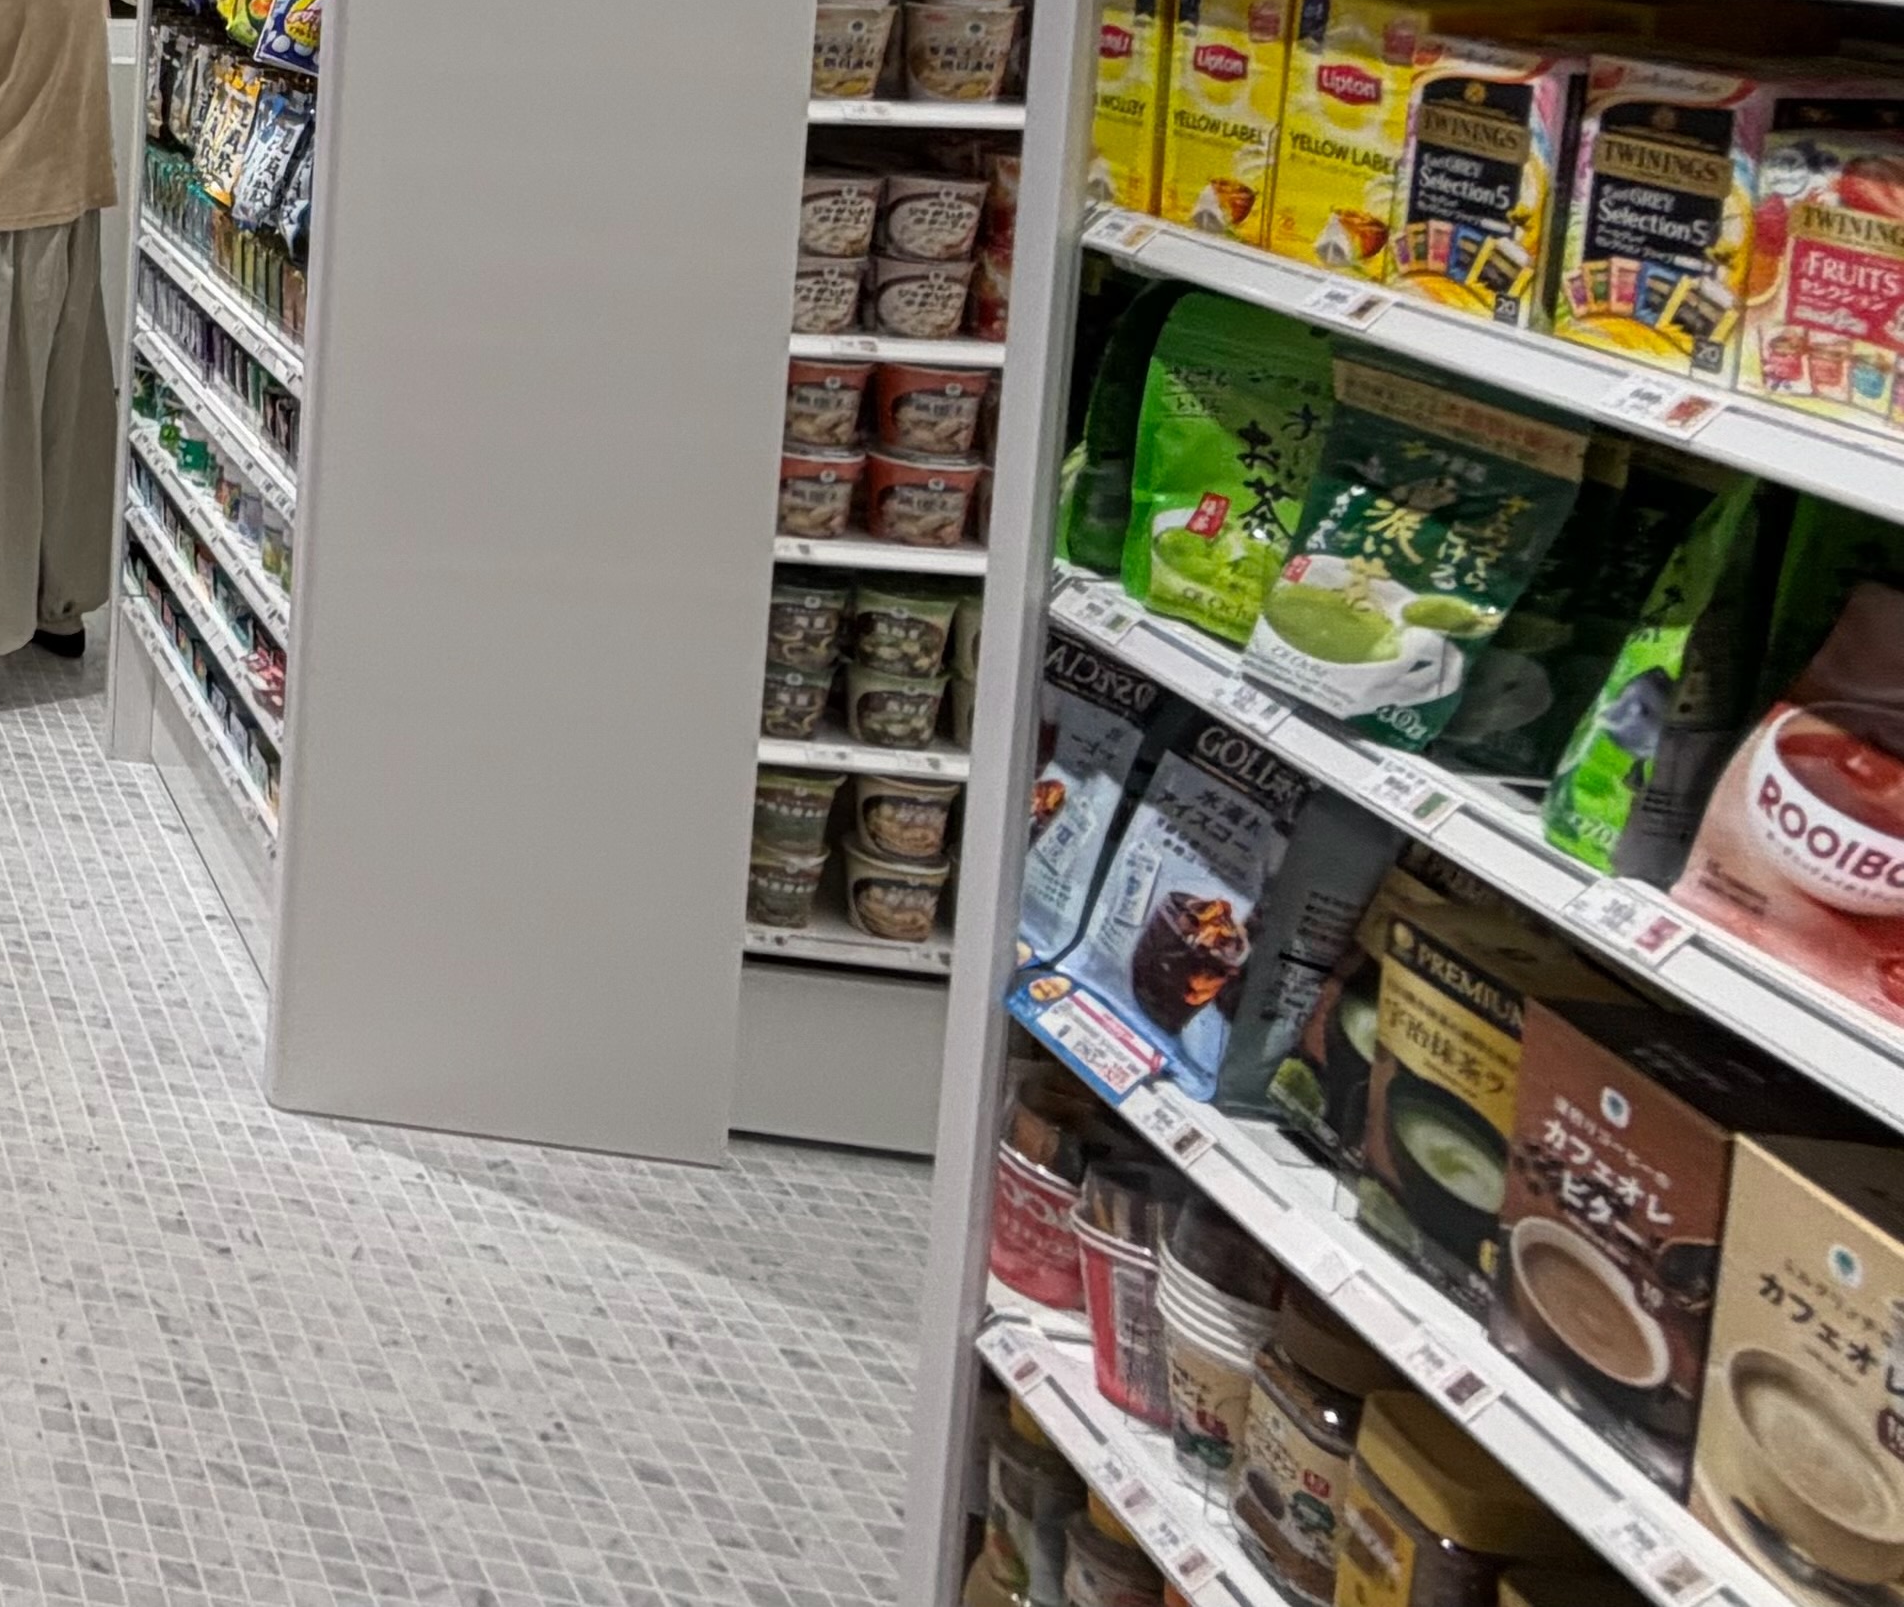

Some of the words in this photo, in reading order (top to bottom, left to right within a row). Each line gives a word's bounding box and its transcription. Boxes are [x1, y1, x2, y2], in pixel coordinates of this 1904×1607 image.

[1194, 45, 1248, 80] Lipton
[1319, 67, 1383, 102] Lipton
[1172, 107, 1223, 141] YELLOW
[1290, 129, 1349, 164] YELLOW
[1605, 140, 1720, 184] TWININGS
[1806, 249, 1903, 297] FRUITS
[1497, 297, 1516, 316] 20
[1697, 343, 1720, 363] 20
